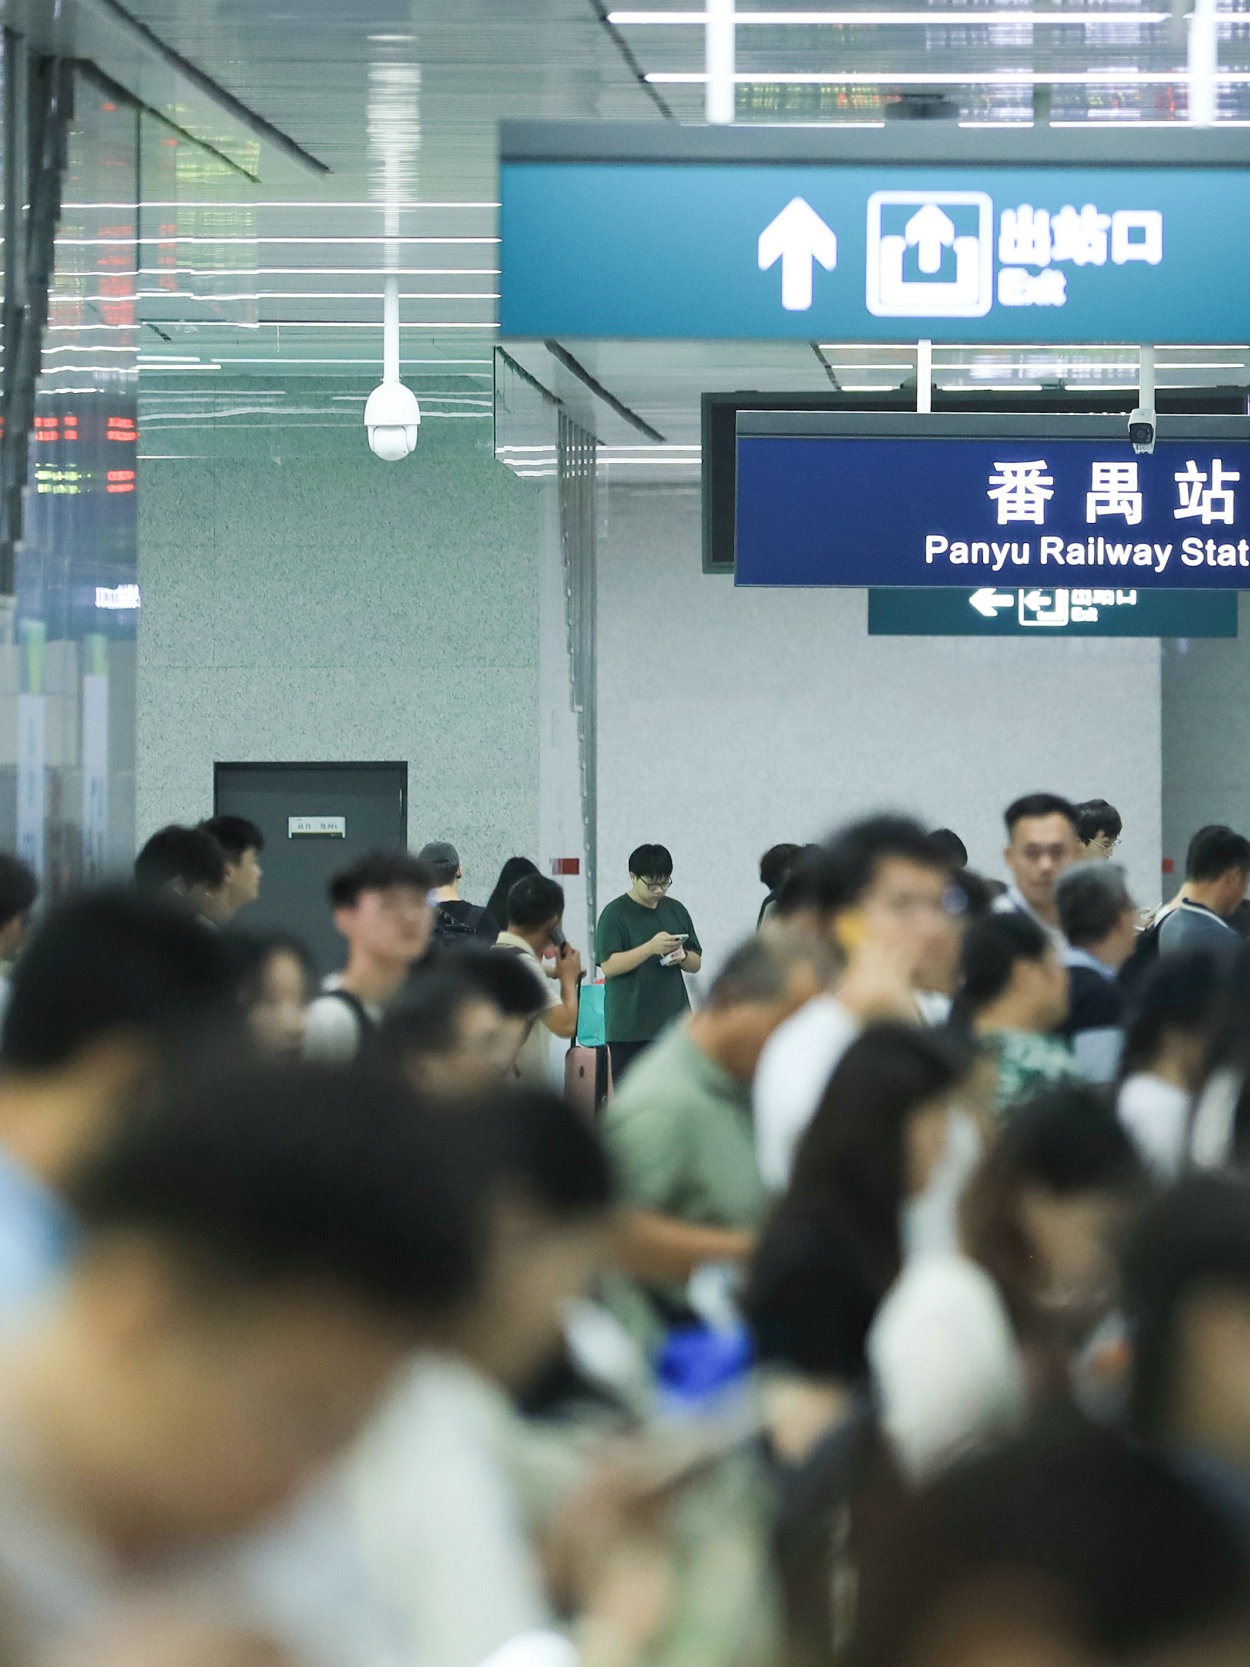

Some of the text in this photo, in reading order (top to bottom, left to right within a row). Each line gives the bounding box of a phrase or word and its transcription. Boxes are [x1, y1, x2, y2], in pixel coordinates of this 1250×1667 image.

[999, 203, 1163, 266] 出站口
[986, 459, 1241, 525] 番禺站
[926, 535, 1030, 572] Panyu
[1041, 536, 1173, 573] Railway
